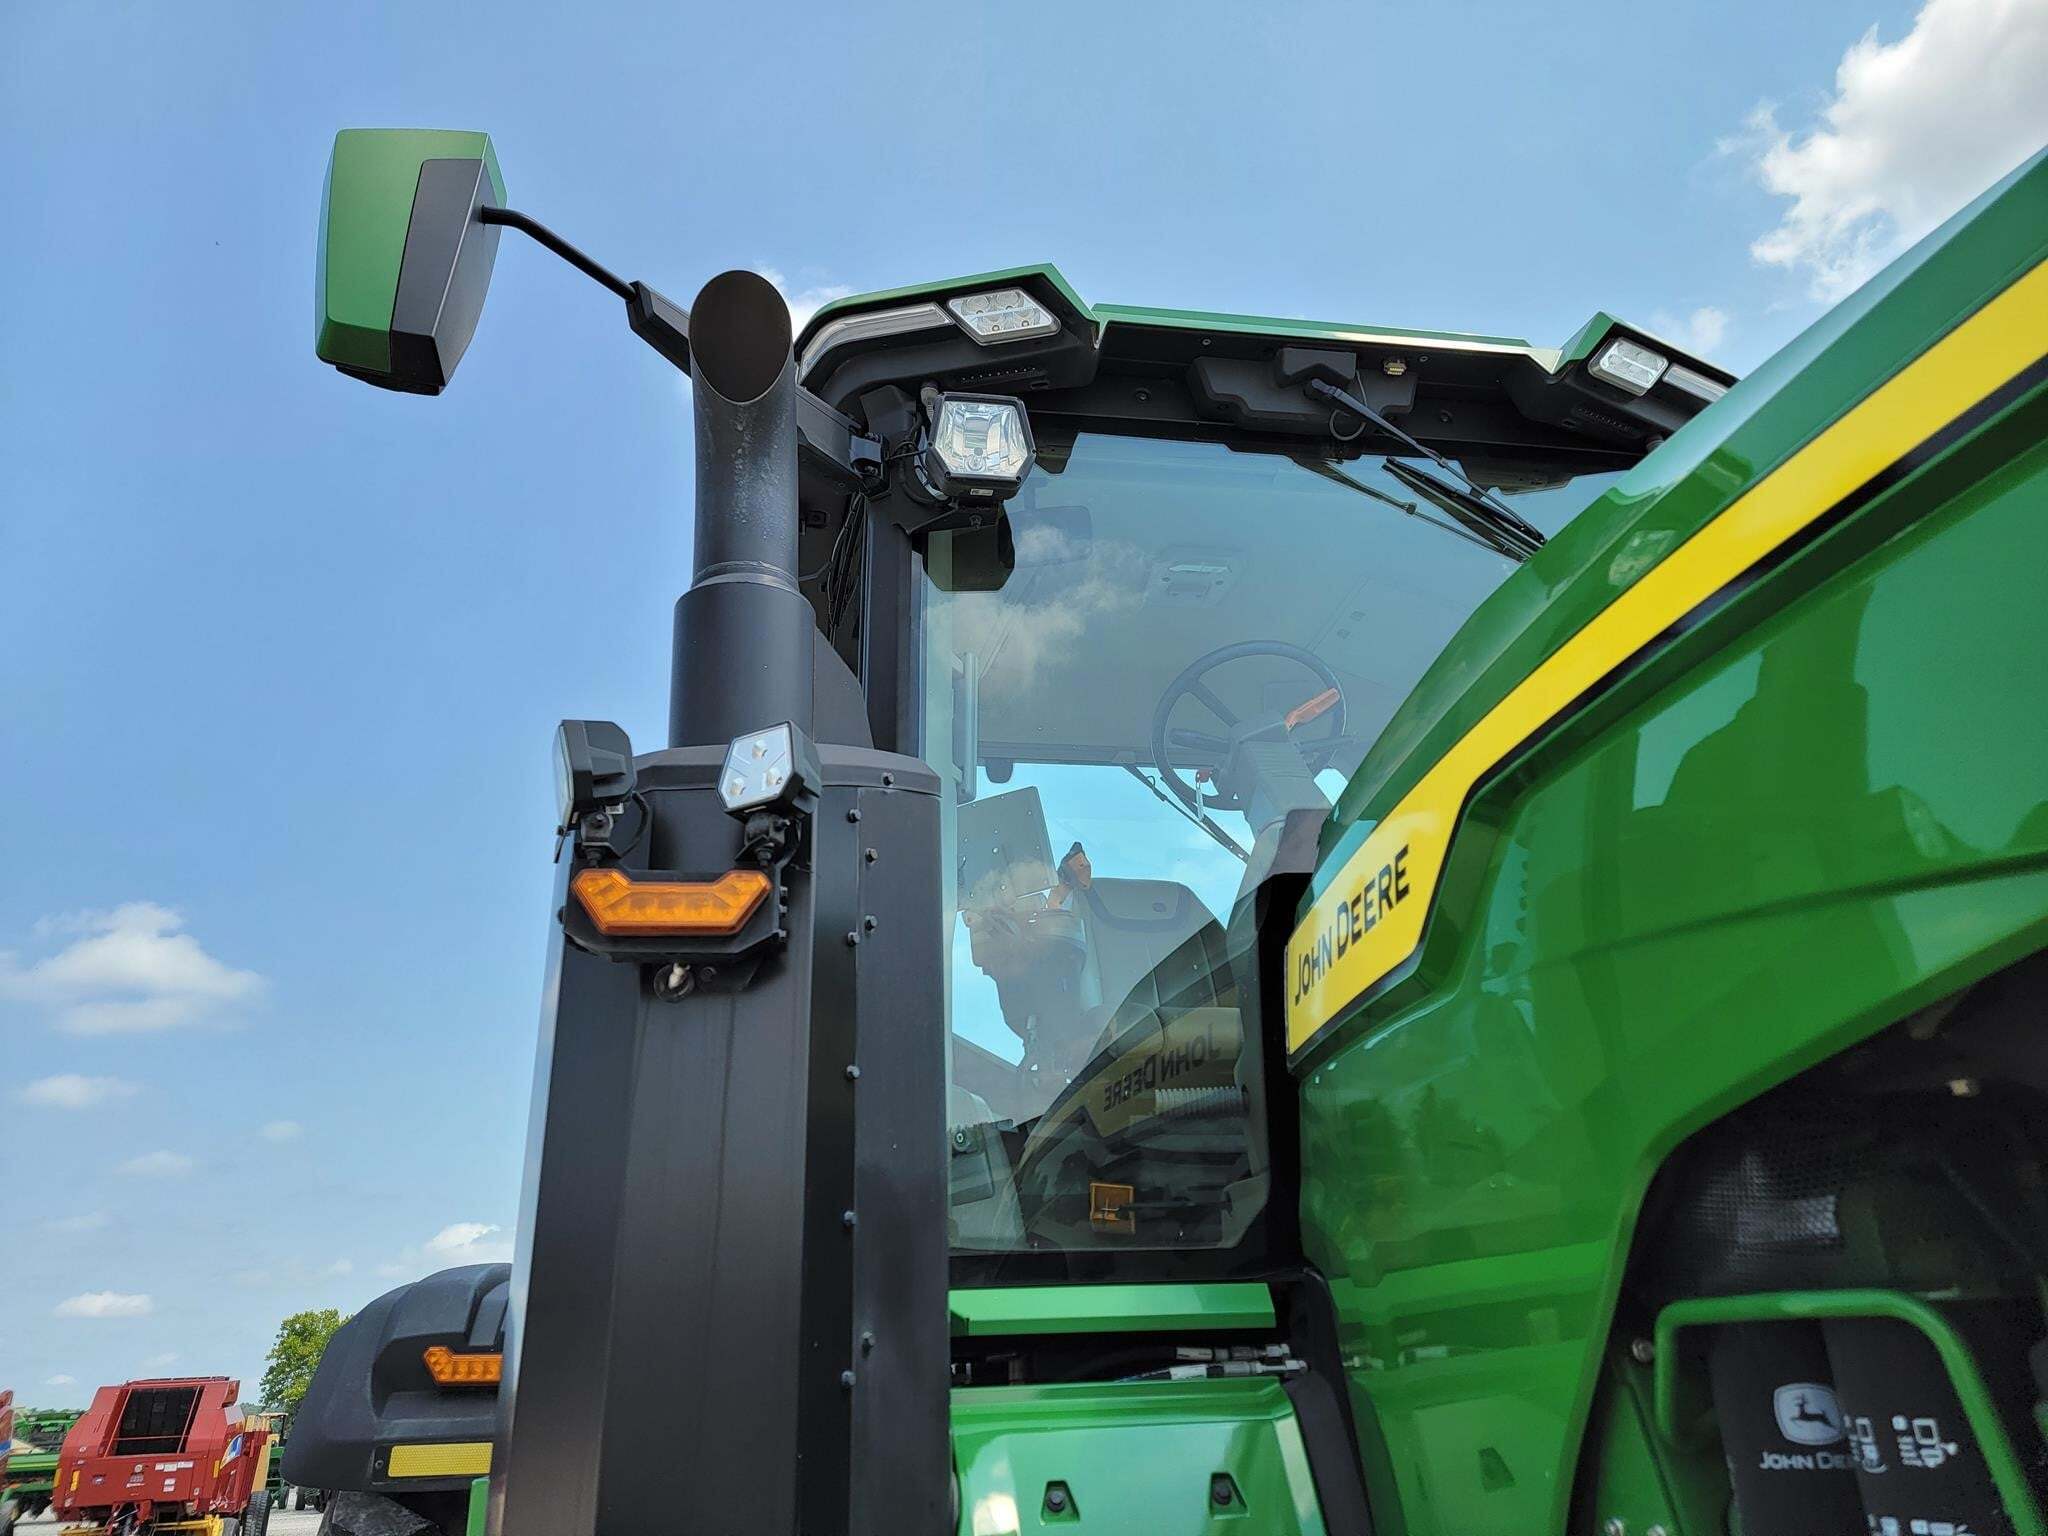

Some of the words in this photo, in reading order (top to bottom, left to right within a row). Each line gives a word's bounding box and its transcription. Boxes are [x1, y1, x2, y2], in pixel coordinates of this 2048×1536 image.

[1295, 926, 1333, 1006] JOHN
[1337, 844, 1410, 960] DEERE
[1759, 1451, 1814, 1470] JOHN
